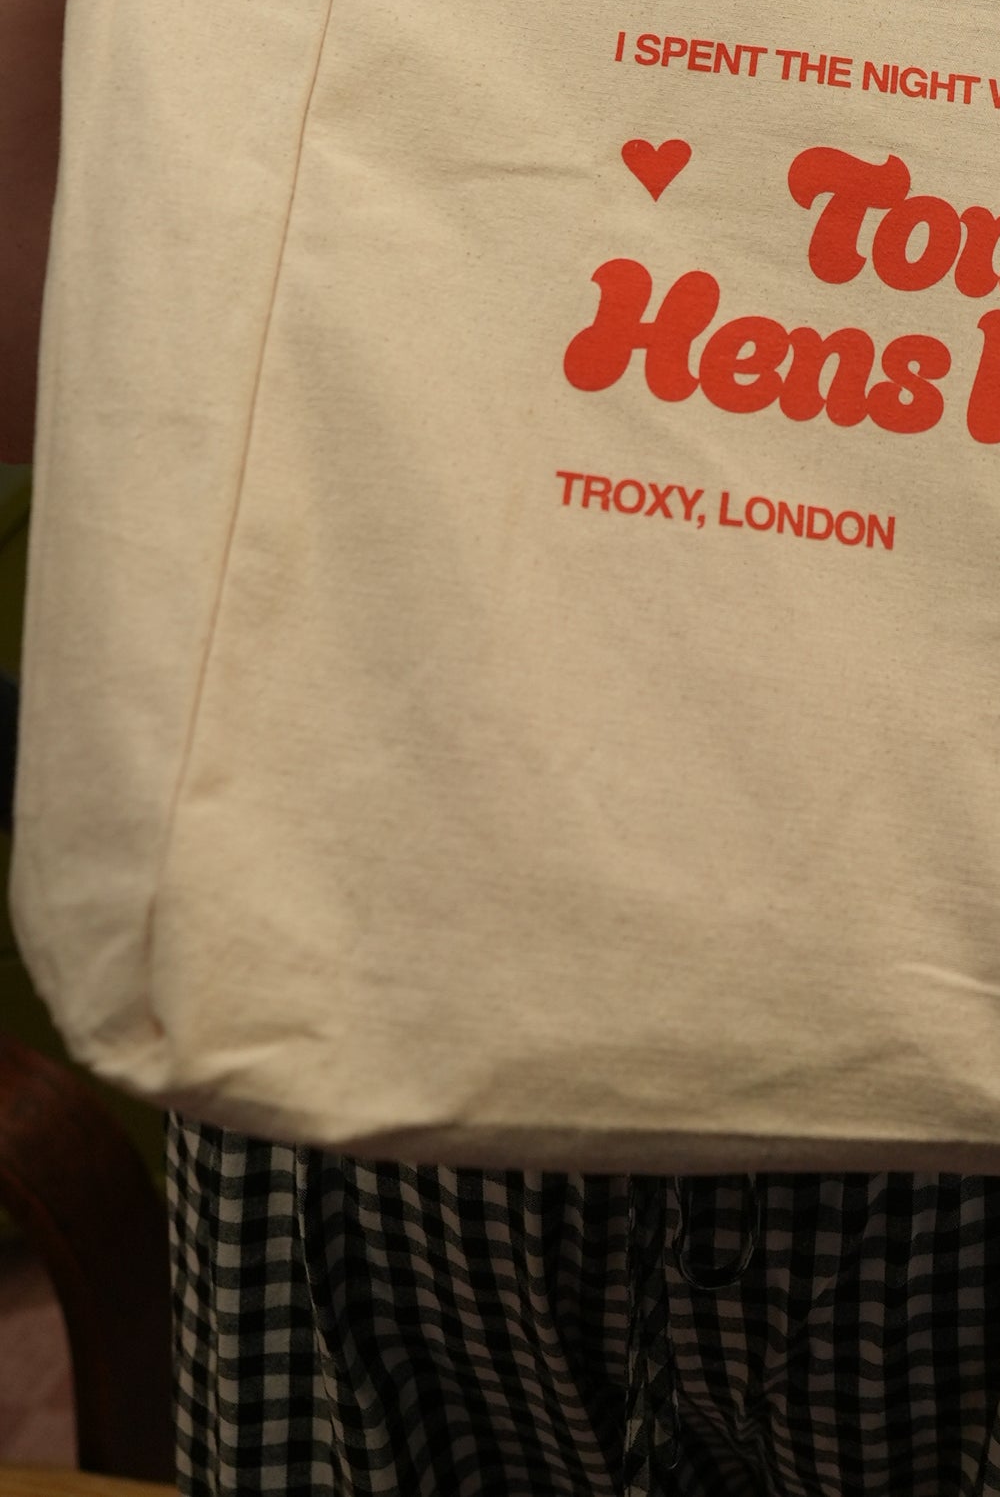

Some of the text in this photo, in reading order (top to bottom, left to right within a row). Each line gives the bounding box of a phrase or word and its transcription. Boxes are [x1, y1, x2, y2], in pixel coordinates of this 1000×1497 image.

[615, 30, 626, 62] I
[634, 33, 769, 77] SPENT
[776, 48, 853, 88] THE
[861, 60, 981, 104] NIGHT
[562, 257, 952, 434] Hens
[556, 470, 896, 550] TROXY, LONDON
